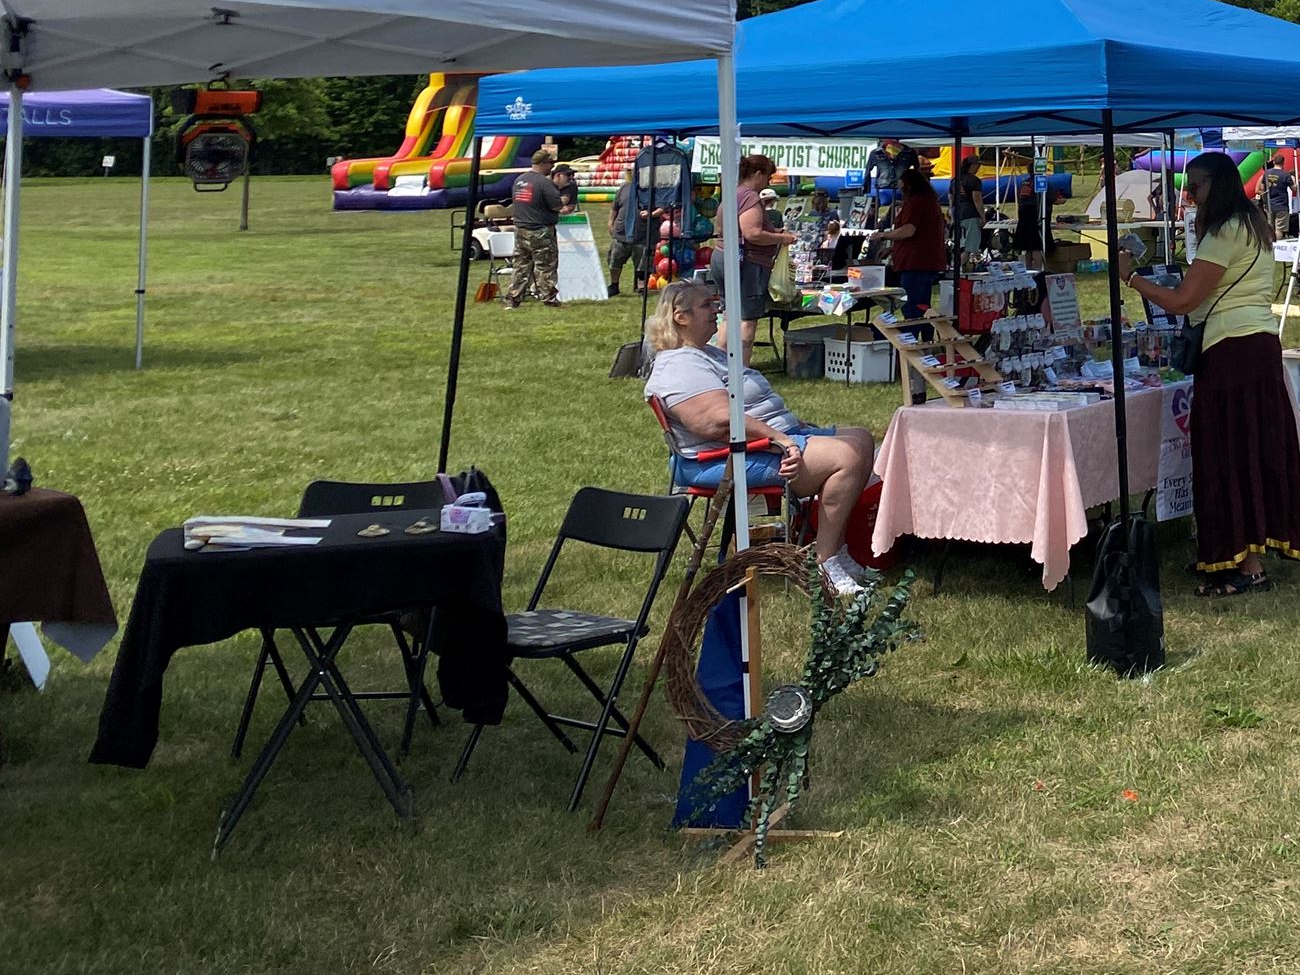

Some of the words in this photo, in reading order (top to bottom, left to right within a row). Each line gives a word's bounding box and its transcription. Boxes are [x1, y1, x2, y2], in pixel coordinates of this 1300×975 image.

[505, 103, 532, 114] SHADE
[818, 145, 867, 169] CHURCH
[1163, 476, 1186, 489] Every
[1175, 488, 1189, 500] Has
